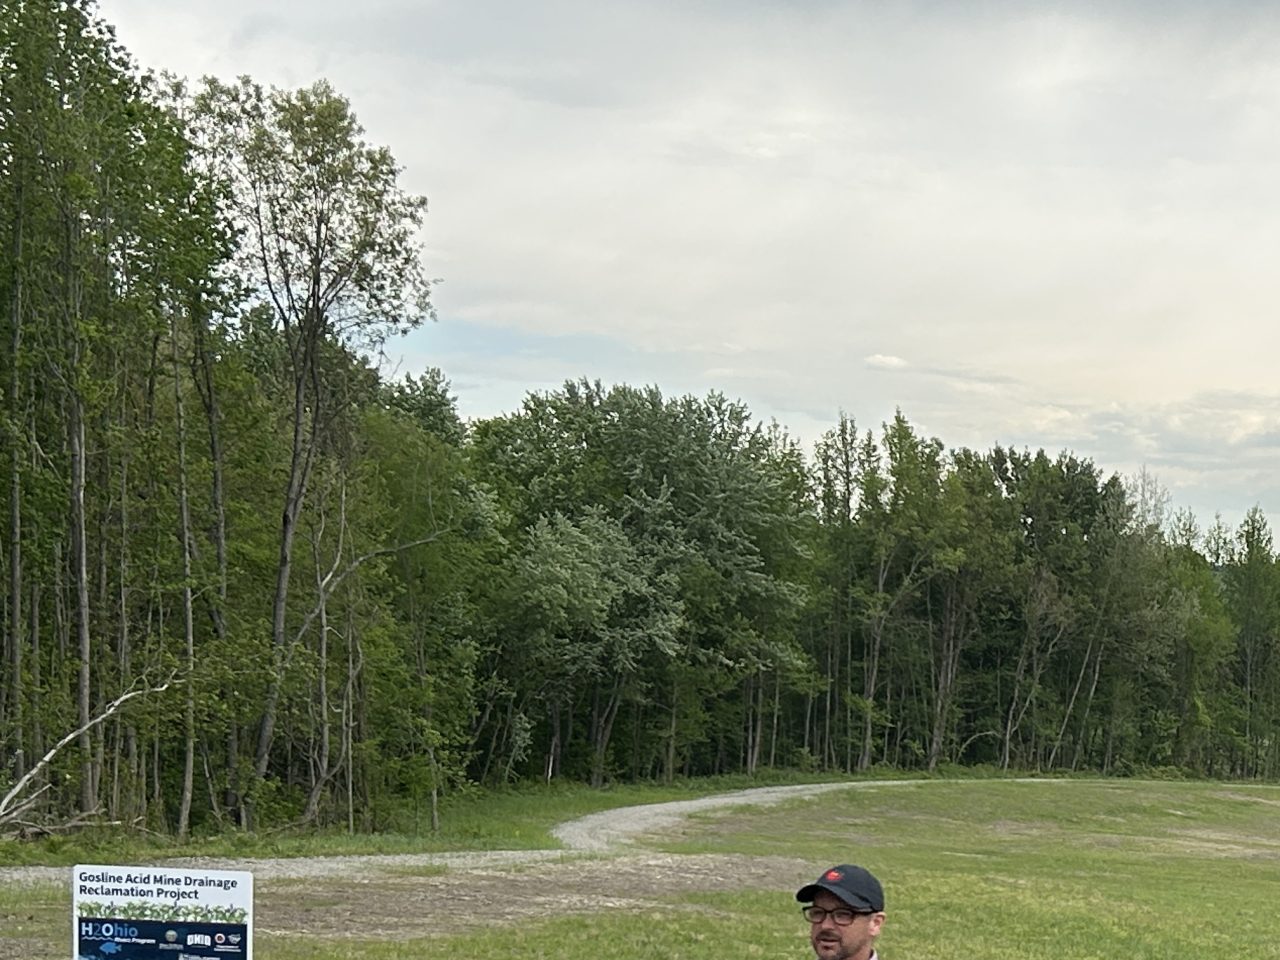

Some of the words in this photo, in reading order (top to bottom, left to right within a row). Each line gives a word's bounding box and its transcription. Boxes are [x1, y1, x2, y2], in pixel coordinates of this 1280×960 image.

[79, 872, 123, 885] Gosline
[125, 873, 150, 885] Acid
[153, 875, 182, 886] Mine
[184, 876, 238, 891] Drainage
[79, 885, 153, 898] Reclamation
[157, 888, 199, 901] Project
[81, 922, 138, 937] H2Ohio
